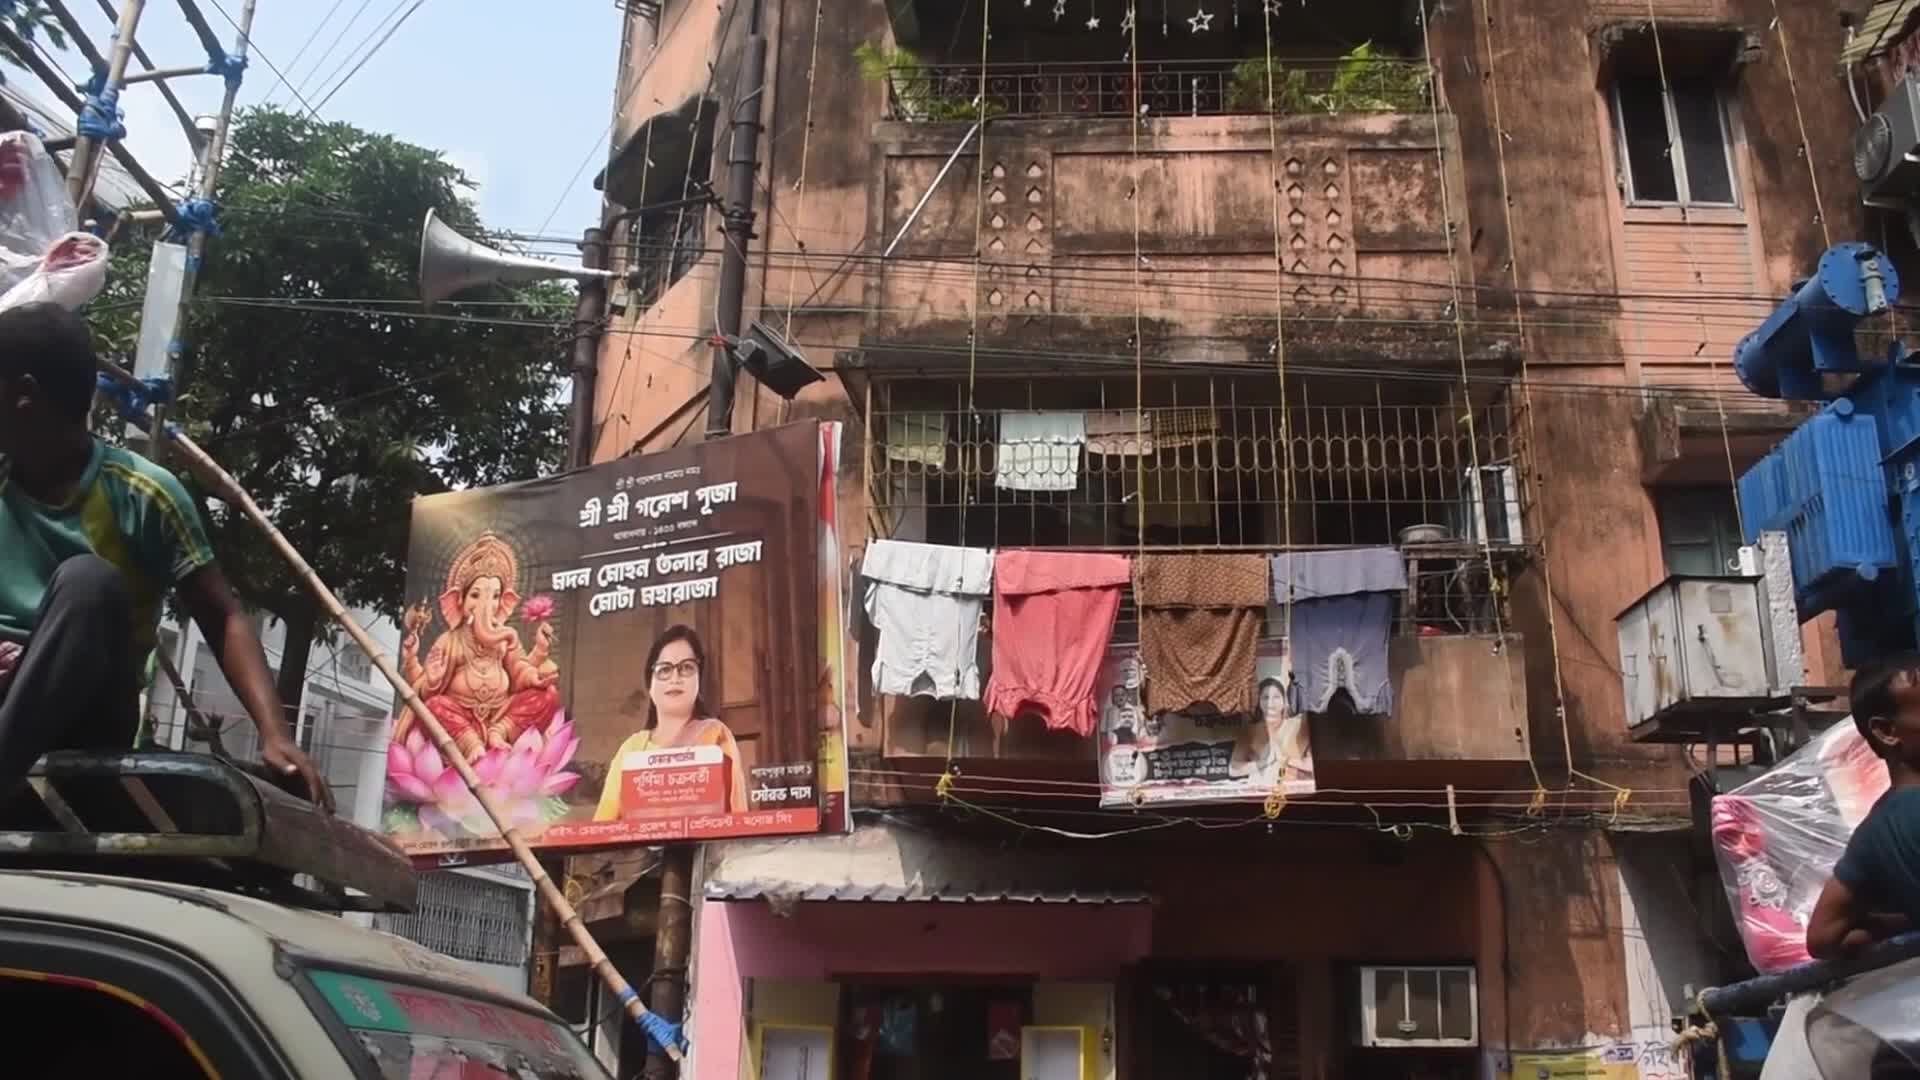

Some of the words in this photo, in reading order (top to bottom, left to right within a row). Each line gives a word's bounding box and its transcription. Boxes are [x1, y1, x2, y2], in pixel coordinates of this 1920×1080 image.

[579, 498, 602, 527] শ্রী
[607, 491, 629, 522] শ্রী
[635, 490, 689, 518] গনেশ
[695, 481, 738, 515] পূজা
[552, 567, 592, 591] মদন
[597, 558, 650, 587] মোহন
[714, 540, 763, 569] রাজা
[589, 585, 636, 616] মোটা
[640, 576, 718, 605] মহারাজা
[752, 783, 788, 802] সৌরভ
[790, 785, 812, 801] দাস
